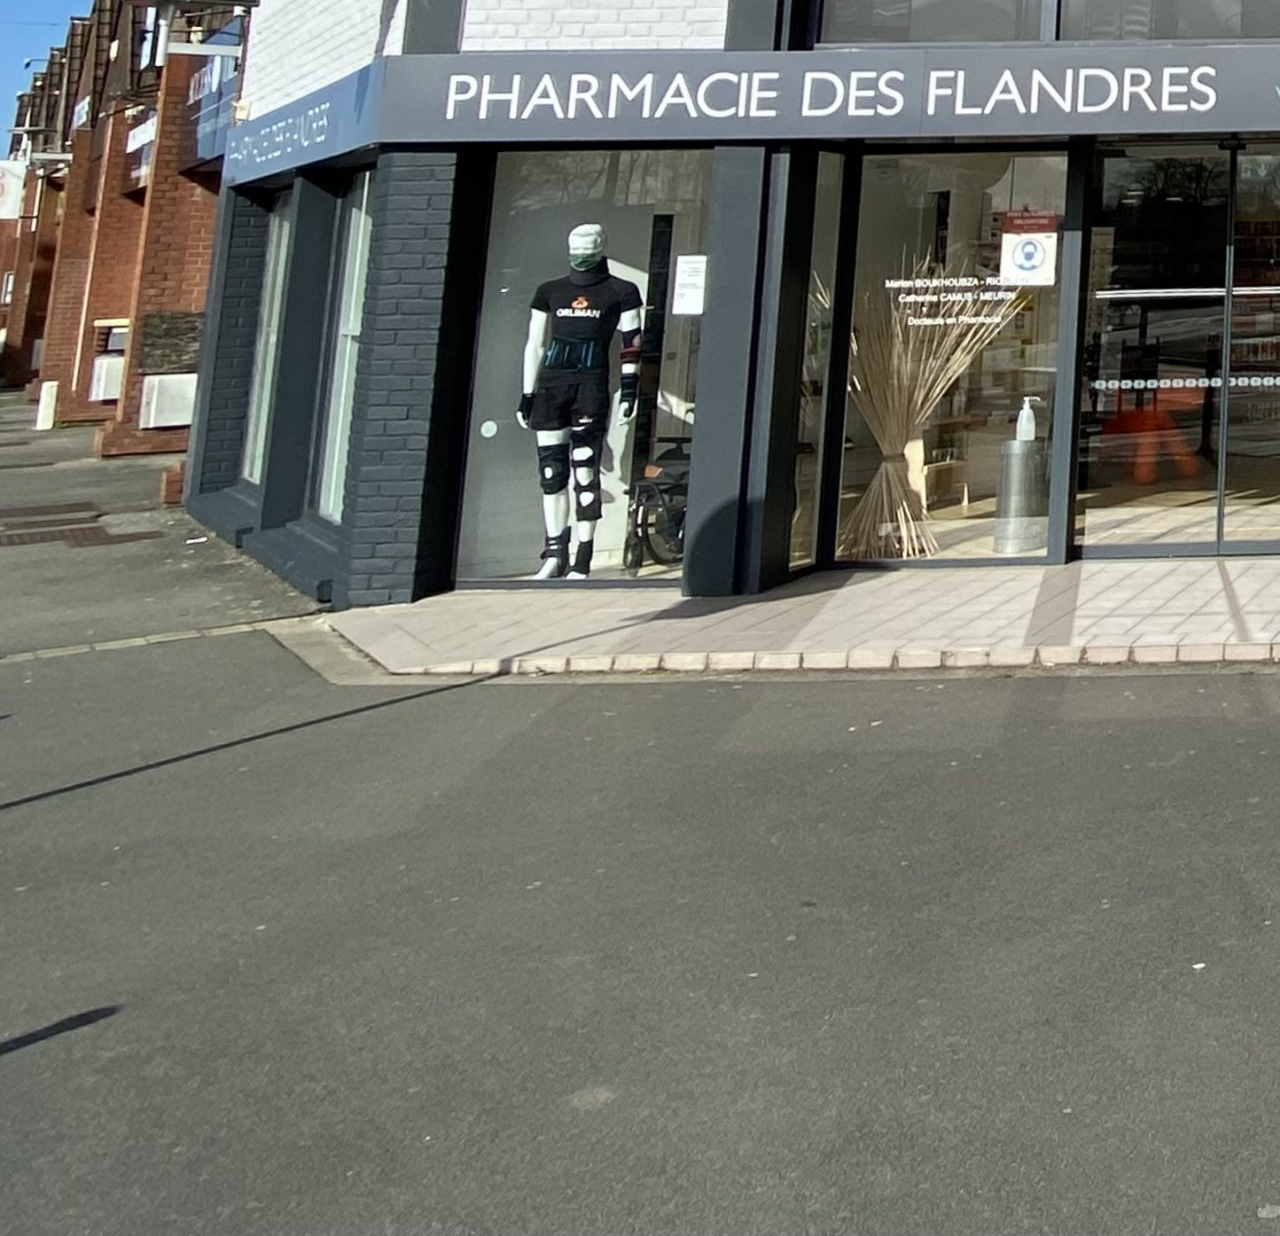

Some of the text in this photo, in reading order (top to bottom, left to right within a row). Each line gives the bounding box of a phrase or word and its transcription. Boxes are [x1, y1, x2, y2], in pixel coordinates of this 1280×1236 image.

[445, 66, 1219, 120] PHARMACIE DES FLANDRES
[555, 308, 601, 318] ORLIMAN
